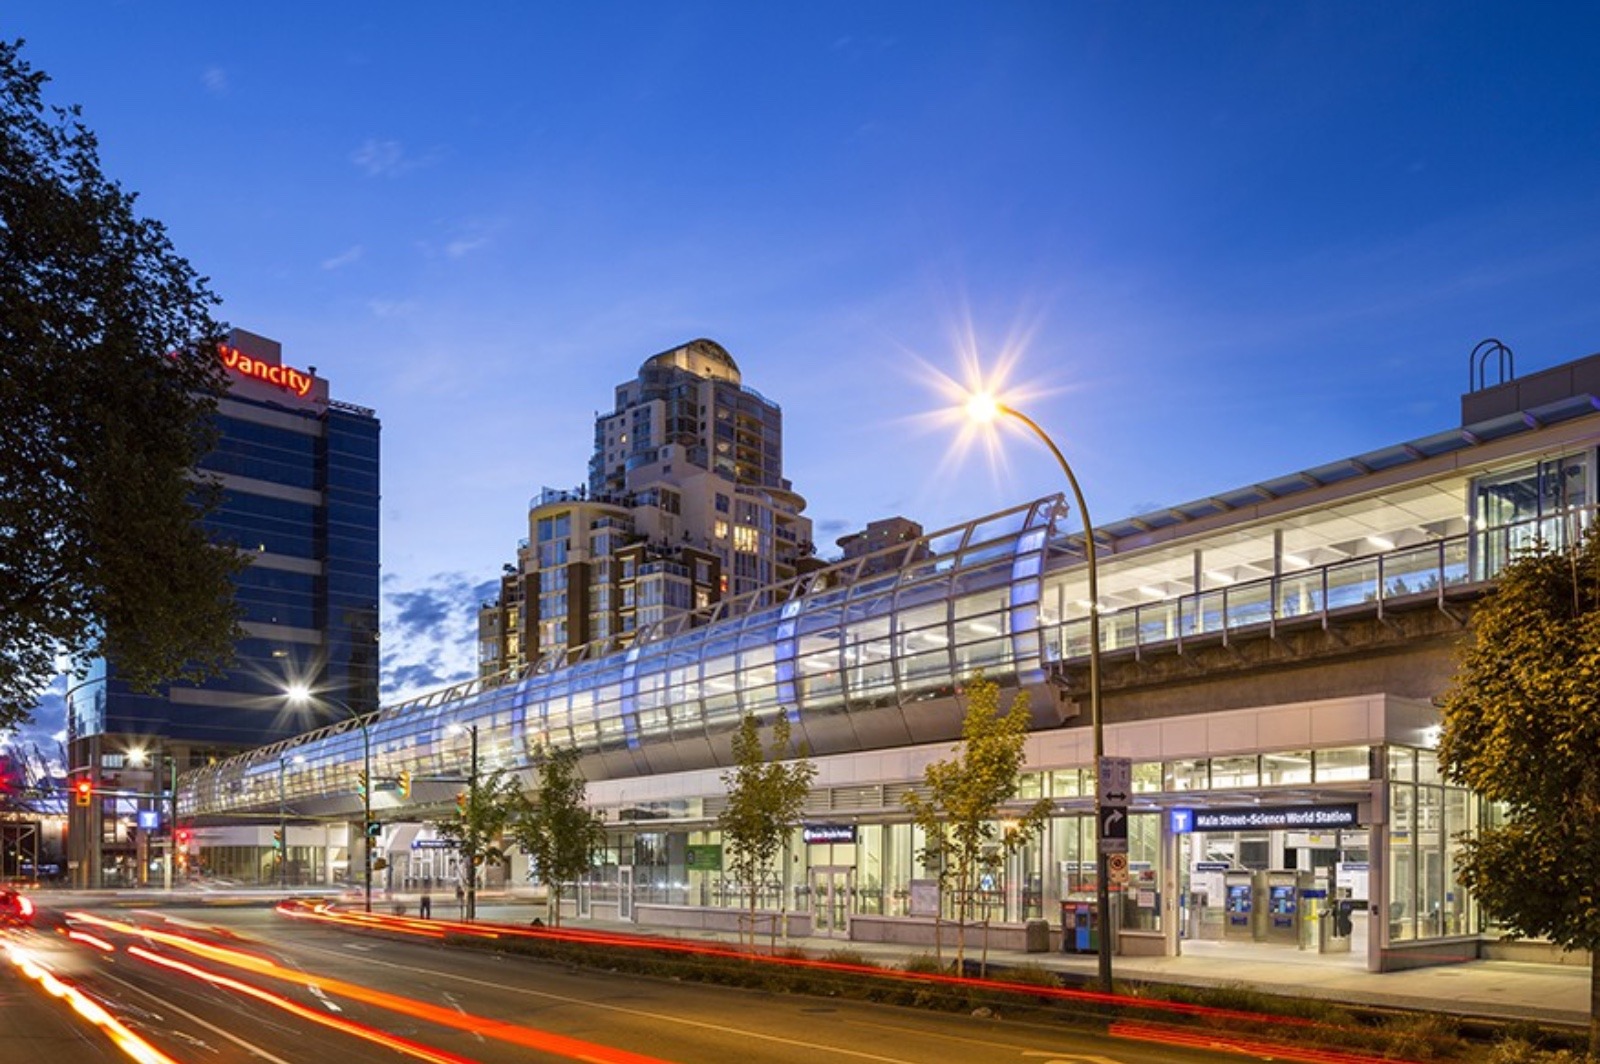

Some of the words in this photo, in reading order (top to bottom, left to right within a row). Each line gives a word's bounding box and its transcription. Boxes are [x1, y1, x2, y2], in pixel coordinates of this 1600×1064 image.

[220, 345, 311, 395] Vancity
[1197, 815, 1218, 827] Main
[1220, 812, 1285, 826] Street-Science
[1286, 811, 1314, 824] World
[1316, 810, 1353, 823] Station
